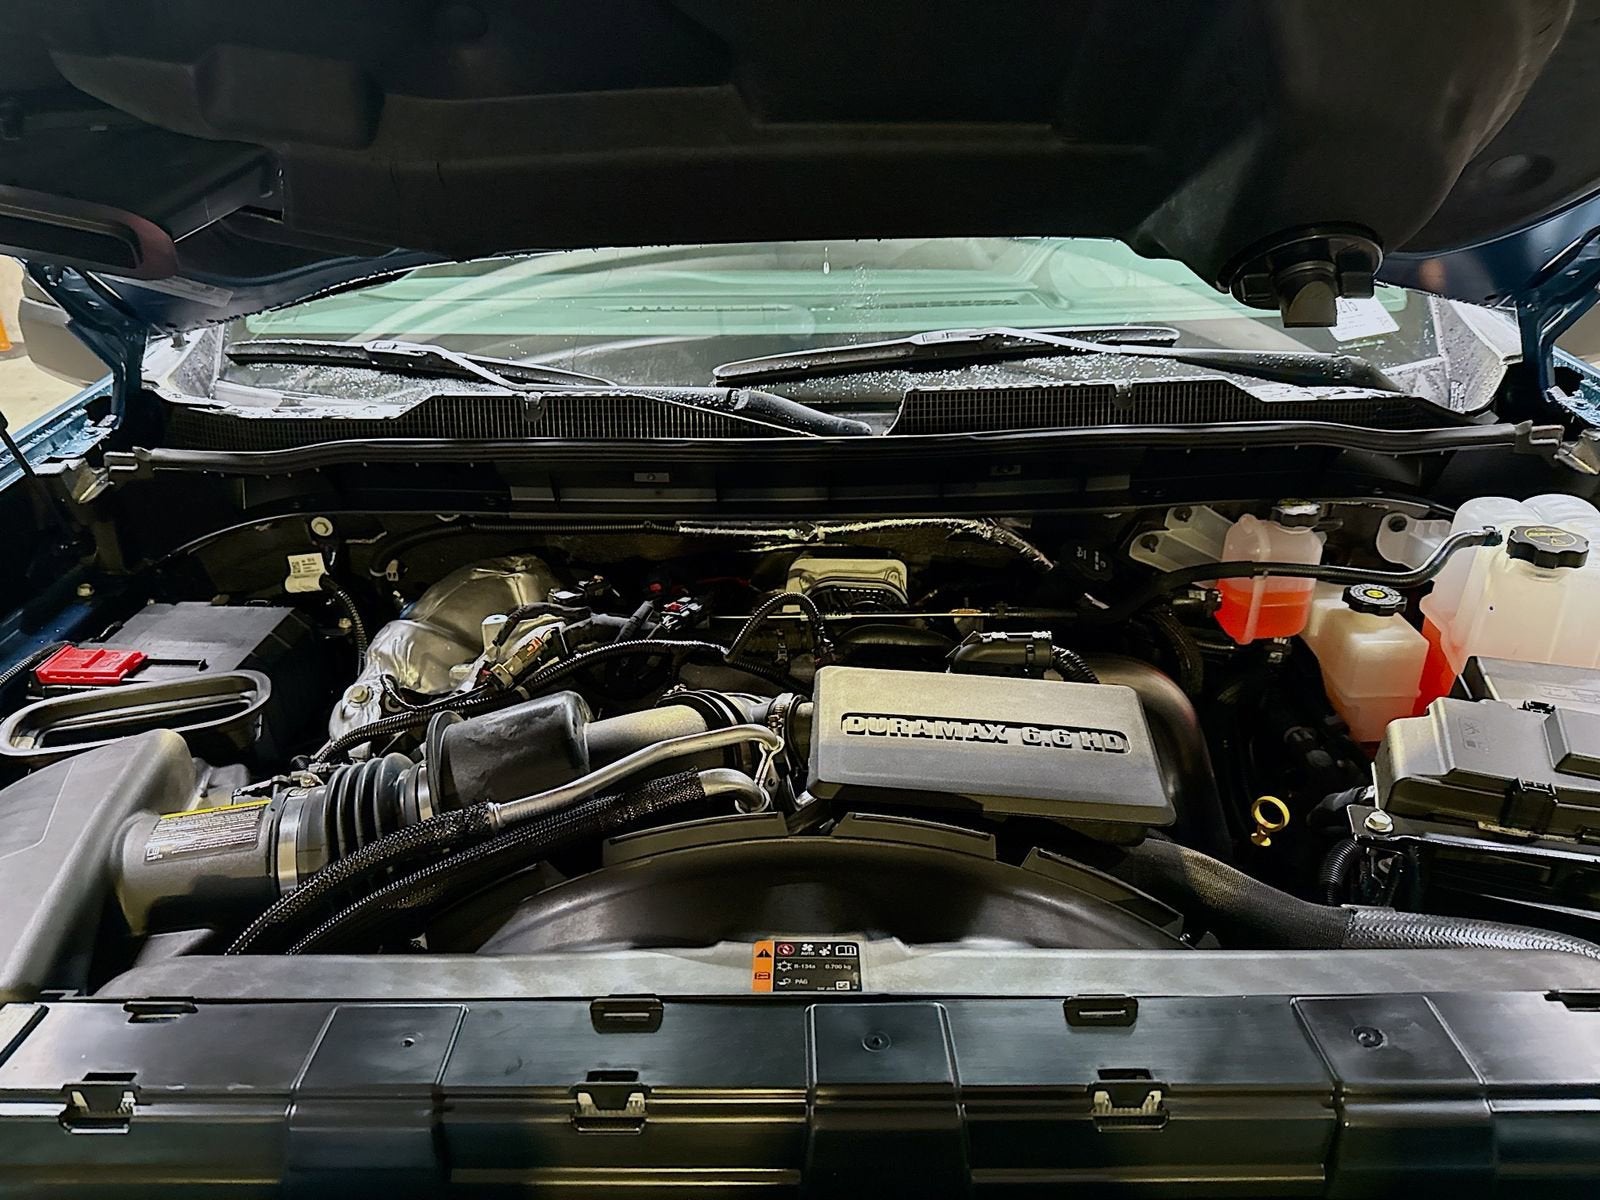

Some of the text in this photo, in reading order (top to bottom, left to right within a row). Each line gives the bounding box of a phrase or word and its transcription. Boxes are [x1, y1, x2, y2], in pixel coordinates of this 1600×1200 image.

[843, 716, 1126, 752] DURAMAX 6.6 HD
